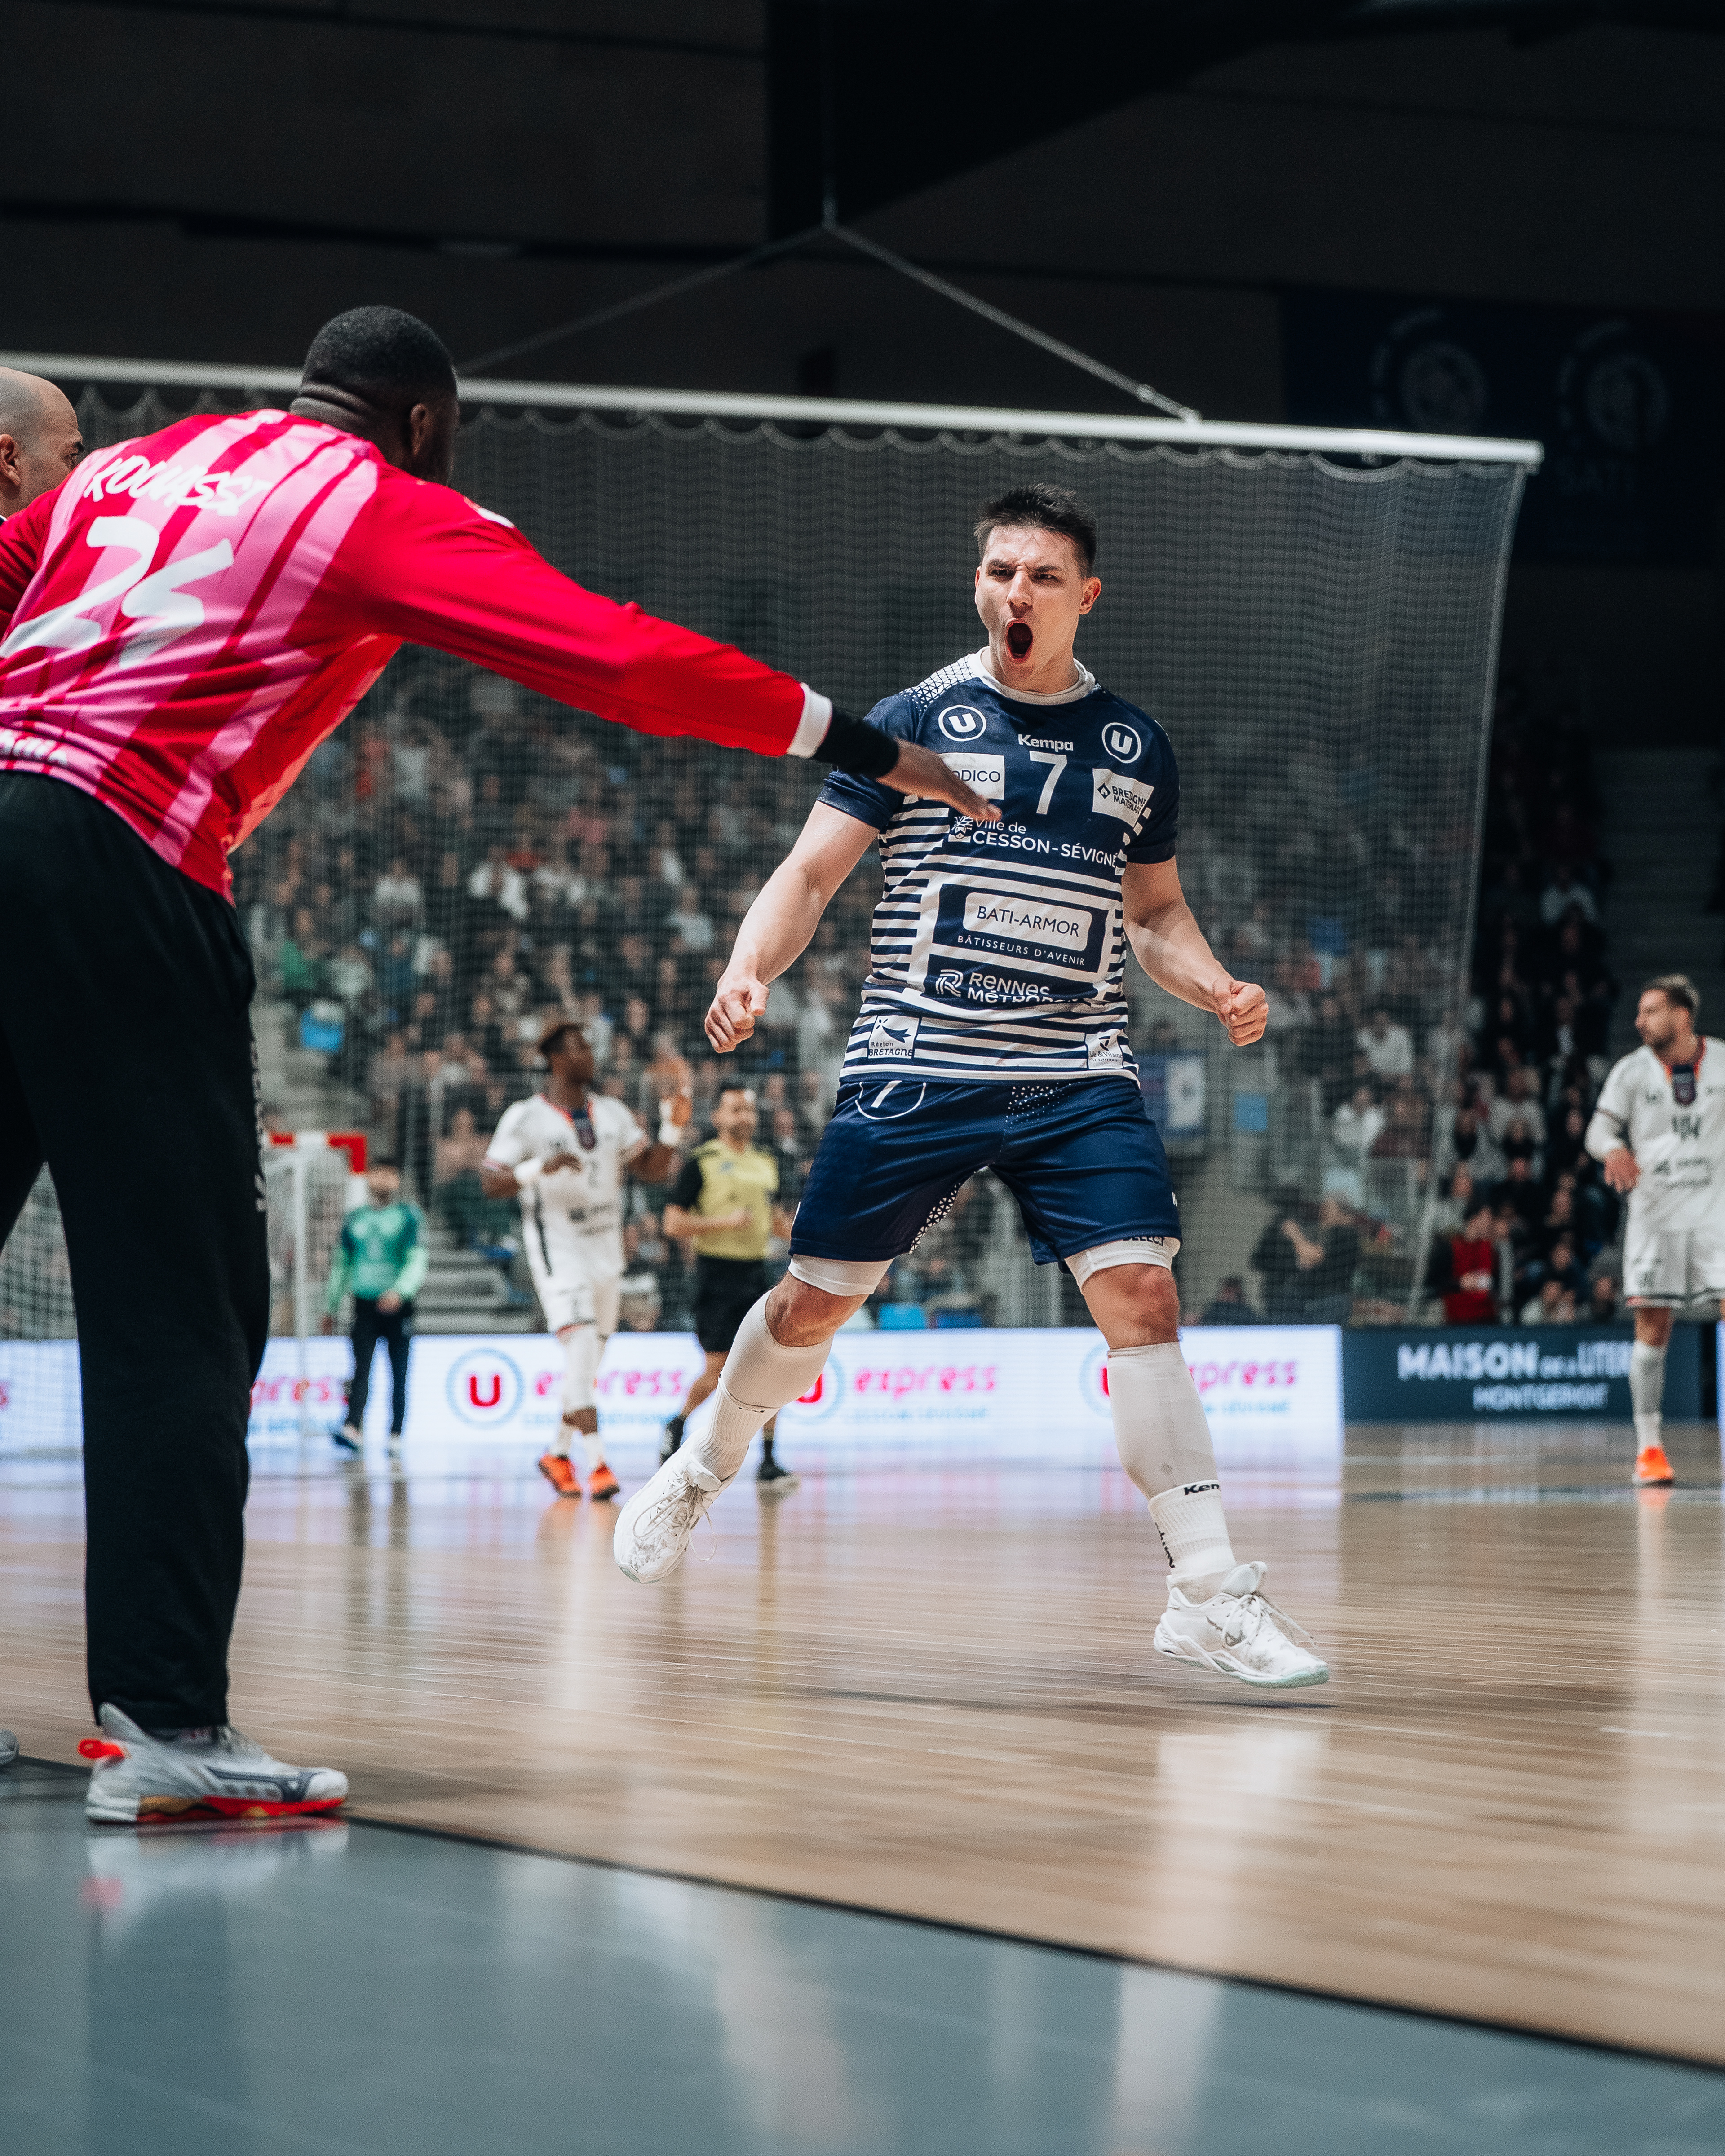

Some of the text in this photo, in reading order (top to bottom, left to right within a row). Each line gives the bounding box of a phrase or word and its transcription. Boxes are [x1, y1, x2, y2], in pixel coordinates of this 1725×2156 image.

[1018, 734, 1073, 752] Kempa
[1029, 751, 1067, 815] 7
[976, 817, 1026, 834] Ville de
[973, 831, 1118, 868] CESSON-SÉVIGNÉ
[977, 906, 1079, 937] BATI-ARMOR
[958, 935, 1084, 965] BÂTISSEURS D'AVENIR
[869, 1048, 913, 1056] BRETAGNE
[1397, 1341, 1539, 1381] MAISON
[854, 1365, 997, 1401] express
